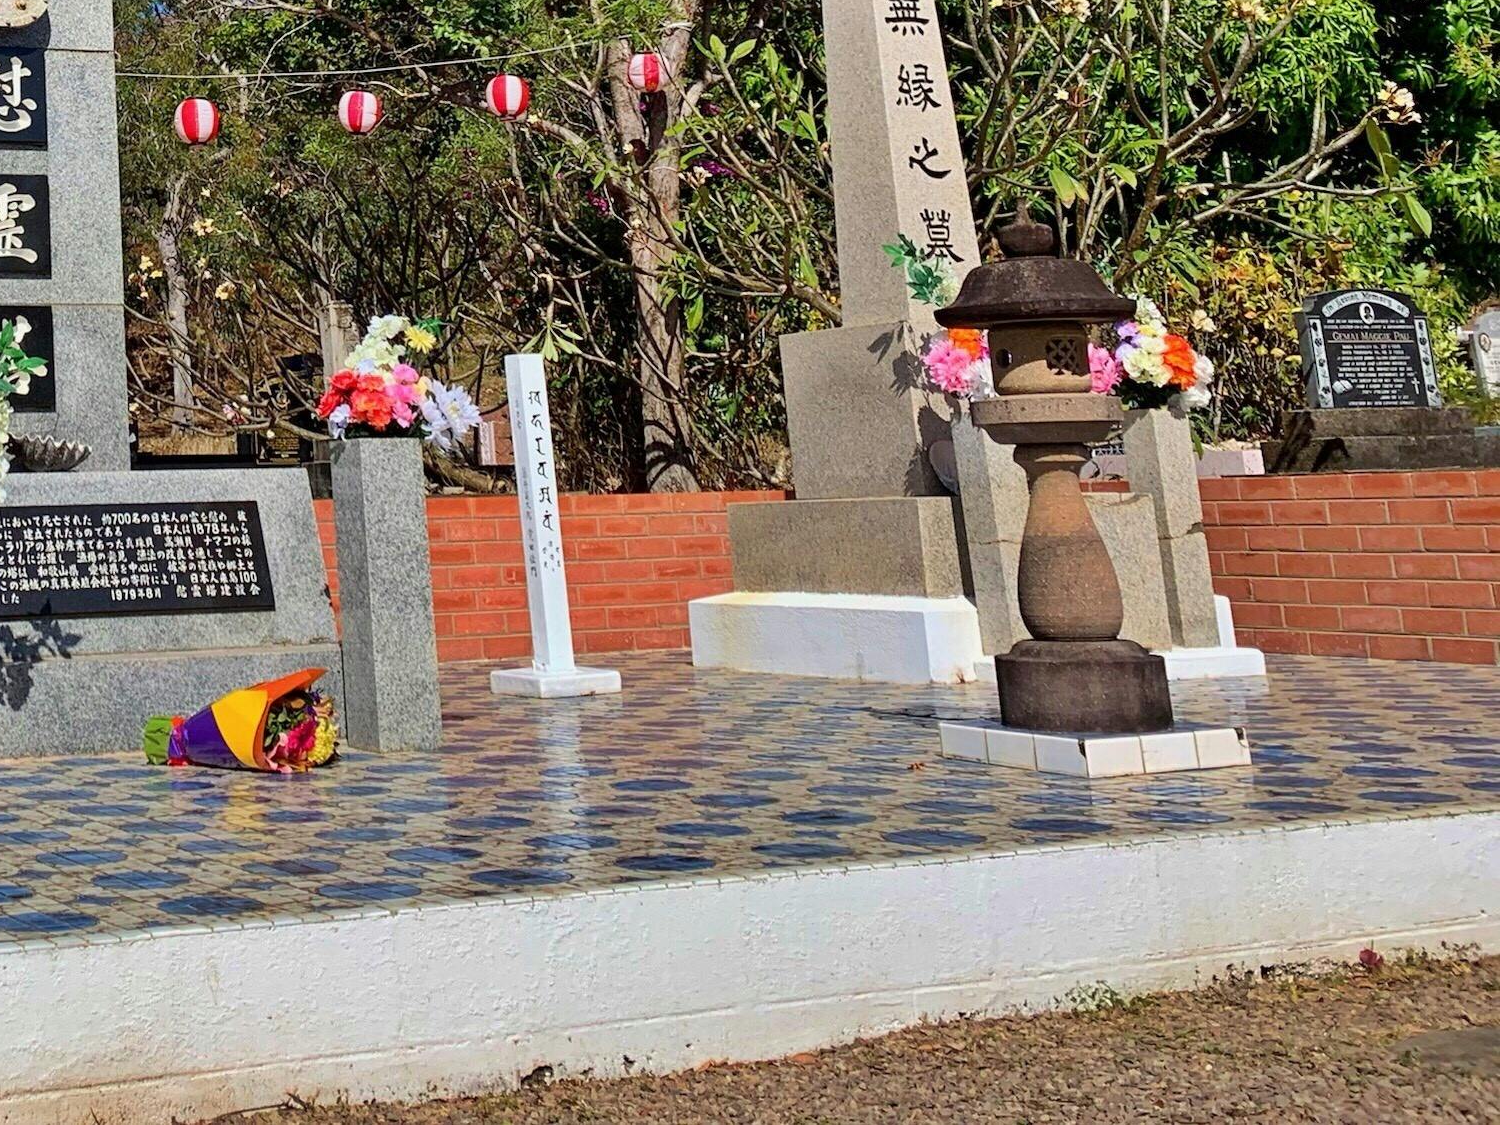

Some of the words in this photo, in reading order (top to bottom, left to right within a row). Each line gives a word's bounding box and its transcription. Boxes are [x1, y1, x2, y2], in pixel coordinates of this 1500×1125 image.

[1361, 291, 1393, 308] Memory
[1361, 331, 1391, 341] MAGGIE
[153, 523, 248, 535] 日本人は1878年から
[235, 548, 253, 558] この
[37, 564, 79, 578] 和歌山県
[88, 562, 158, 576] 愛媛県を中心に
[111, 587, 161, 601] 1979年8月
